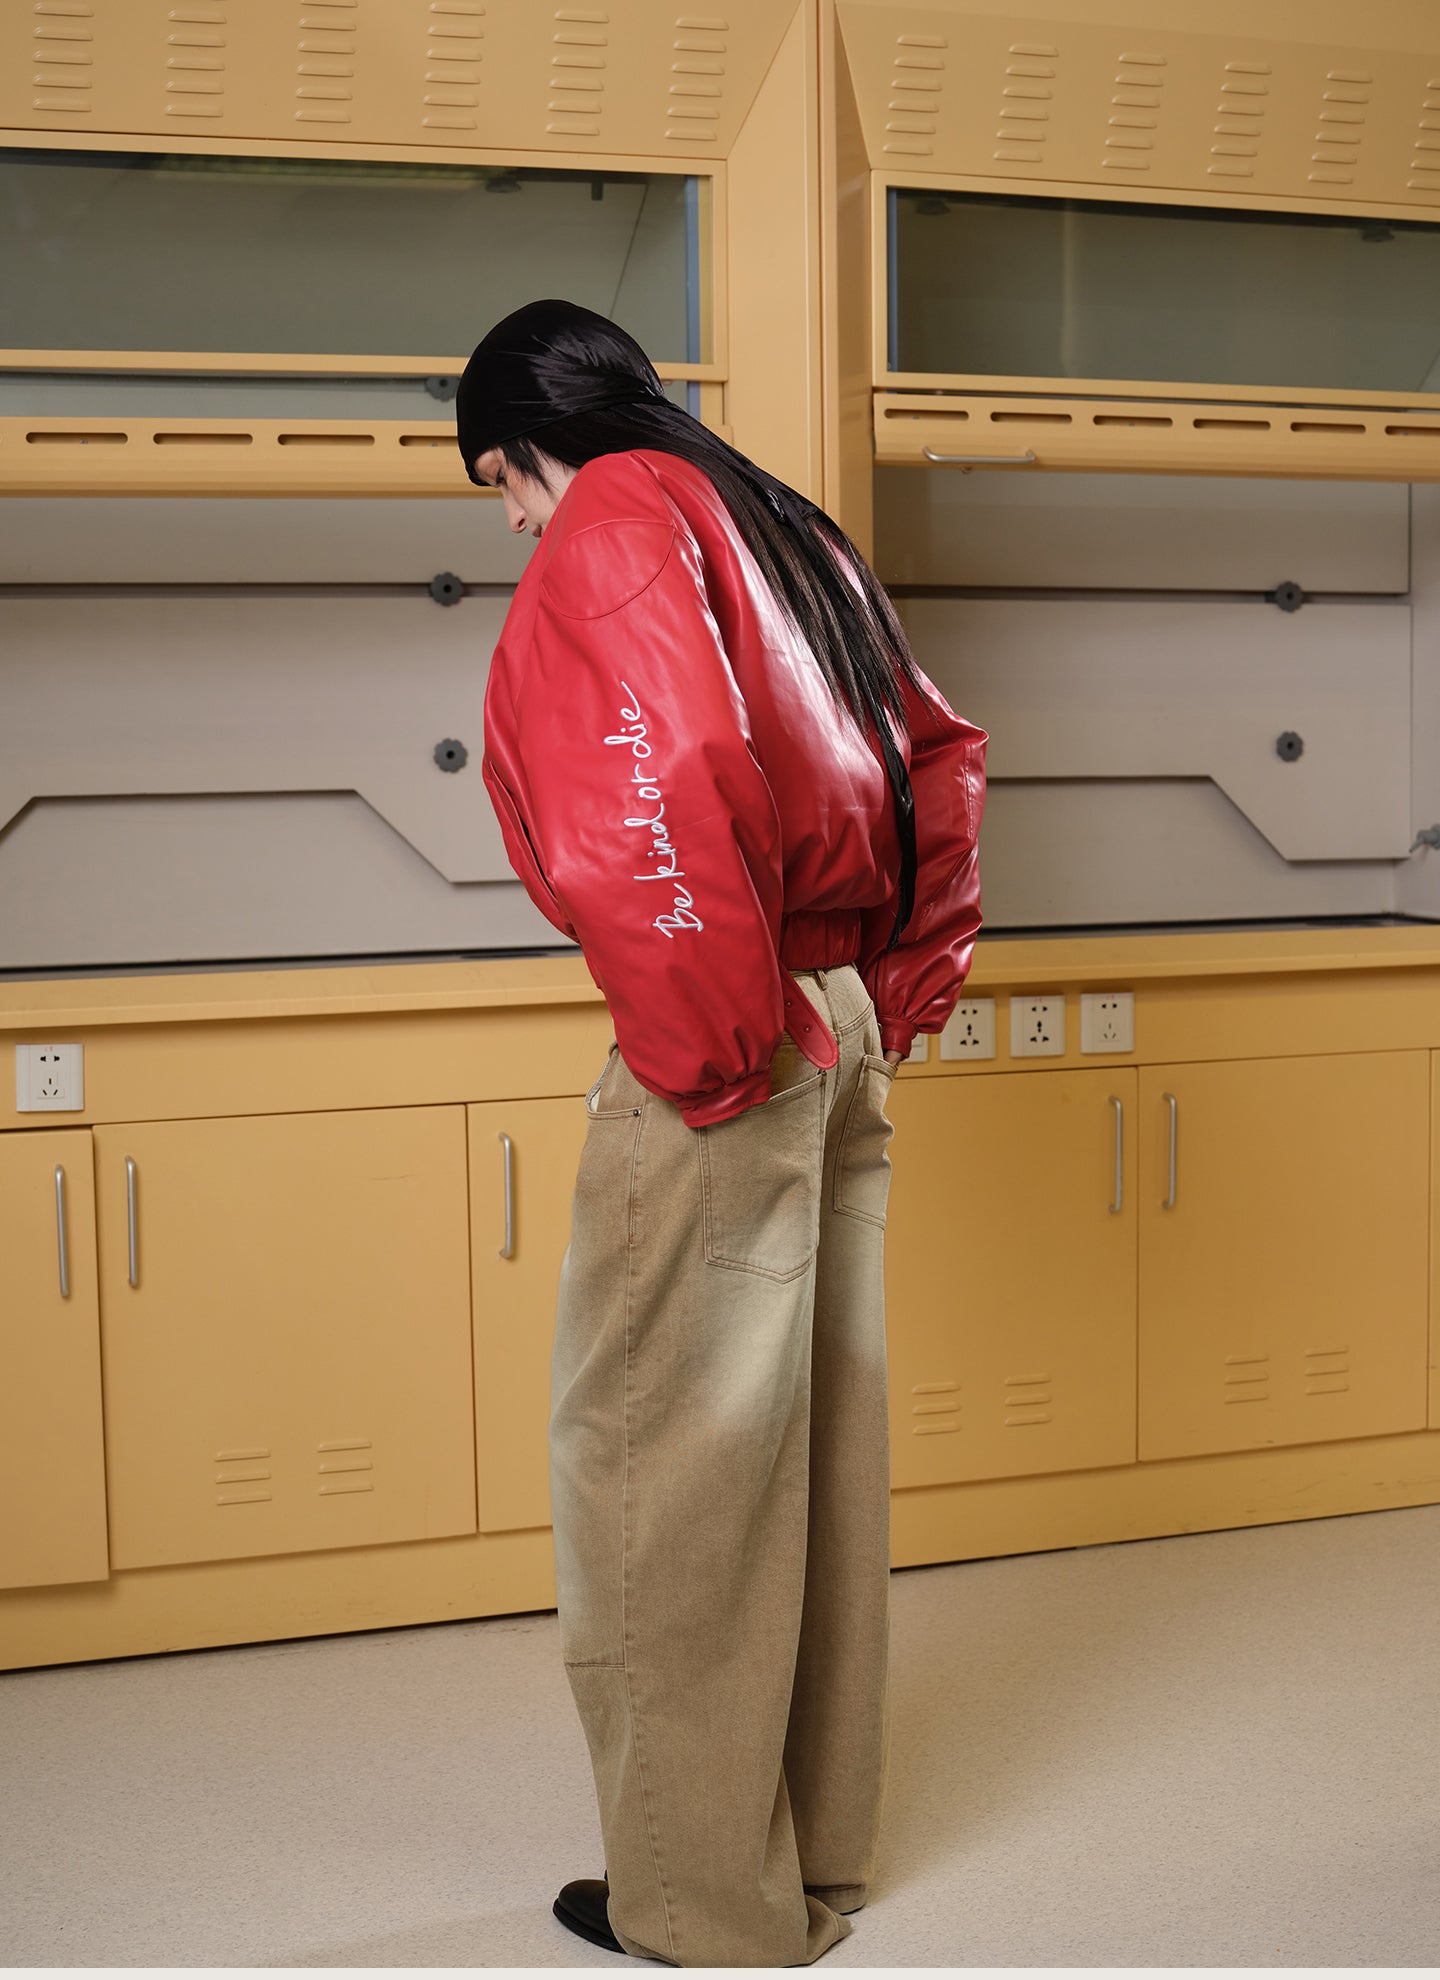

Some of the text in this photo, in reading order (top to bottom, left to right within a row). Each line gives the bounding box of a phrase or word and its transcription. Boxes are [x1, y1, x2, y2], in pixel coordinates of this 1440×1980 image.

[603, 680, 703, 938] Be kind or die
